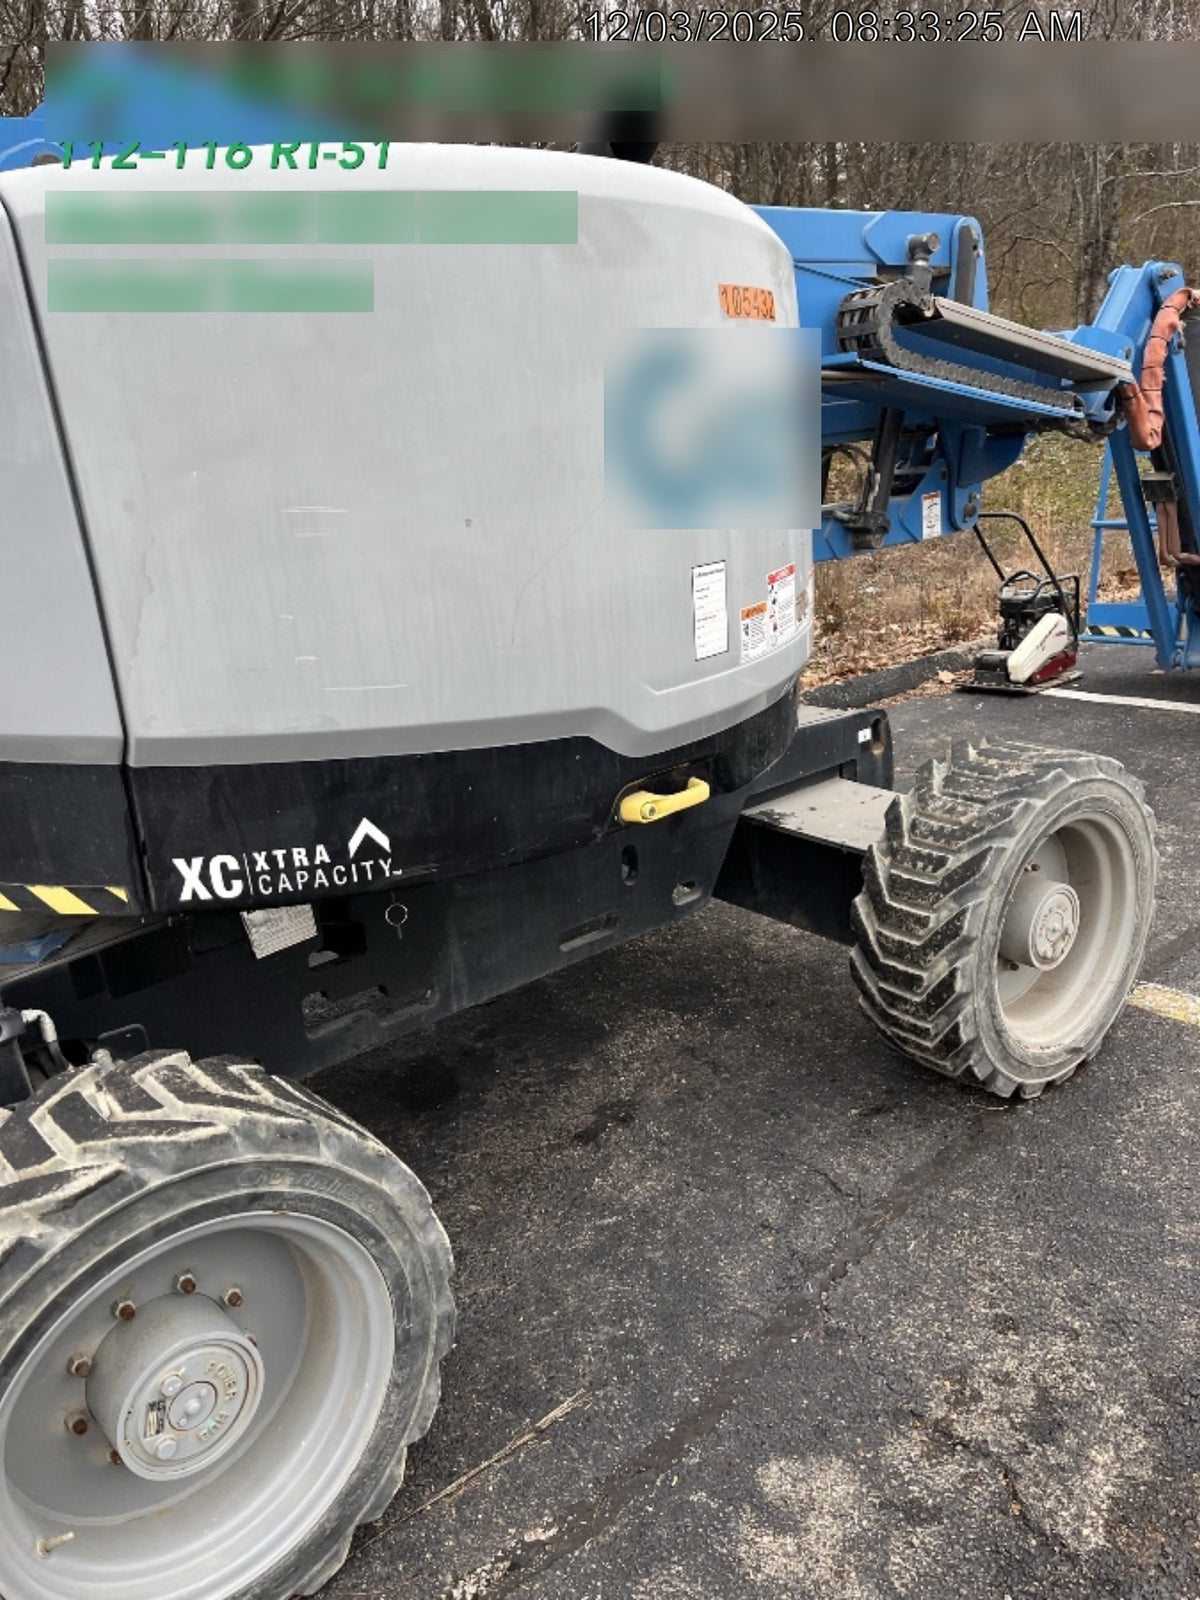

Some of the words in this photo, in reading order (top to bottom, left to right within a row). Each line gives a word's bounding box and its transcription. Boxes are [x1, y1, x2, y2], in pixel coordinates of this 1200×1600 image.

[251, 844, 331, 872] XTRA
[258, 858, 393, 895] CAPACITY
[172, 854, 244, 902] XC
